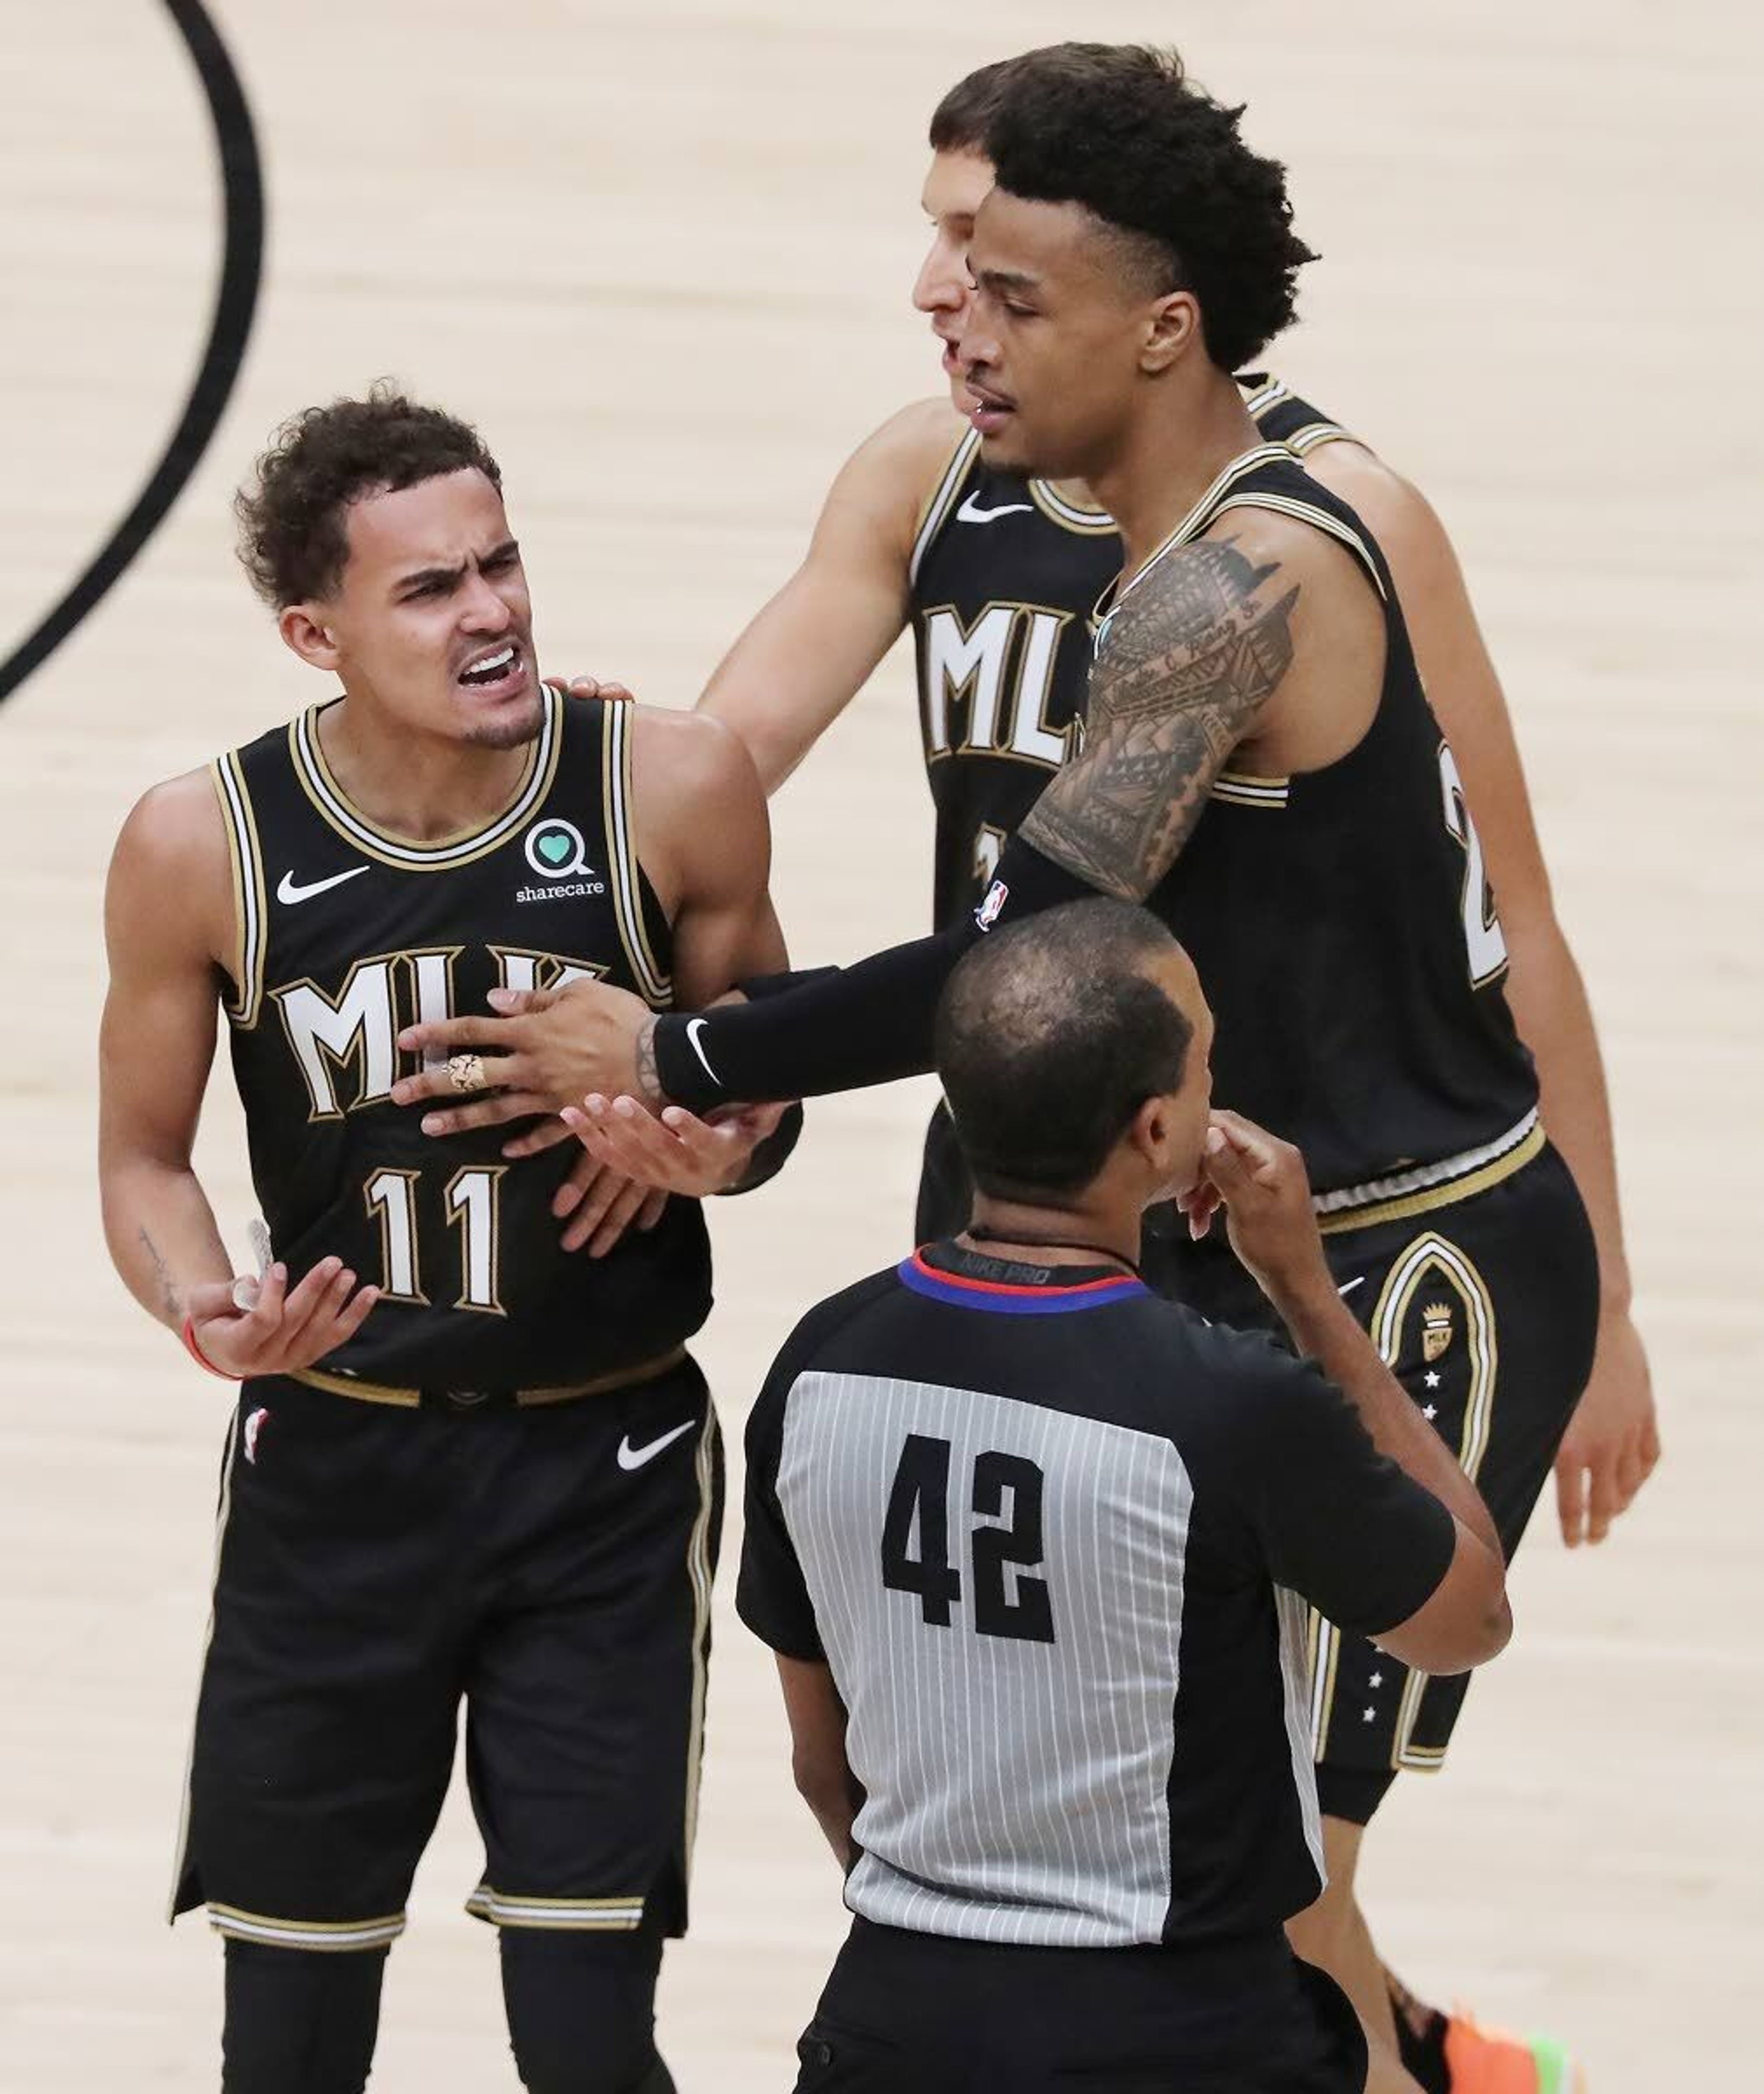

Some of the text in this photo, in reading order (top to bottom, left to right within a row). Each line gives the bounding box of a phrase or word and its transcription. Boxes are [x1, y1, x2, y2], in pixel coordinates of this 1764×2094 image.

[516, 882, 605, 903] sharecare
[363, 1165, 510, 1317] 11
[962, 1252, 1051, 1285] NIKE PRO
[881, 1433, 1055, 1644] 42
